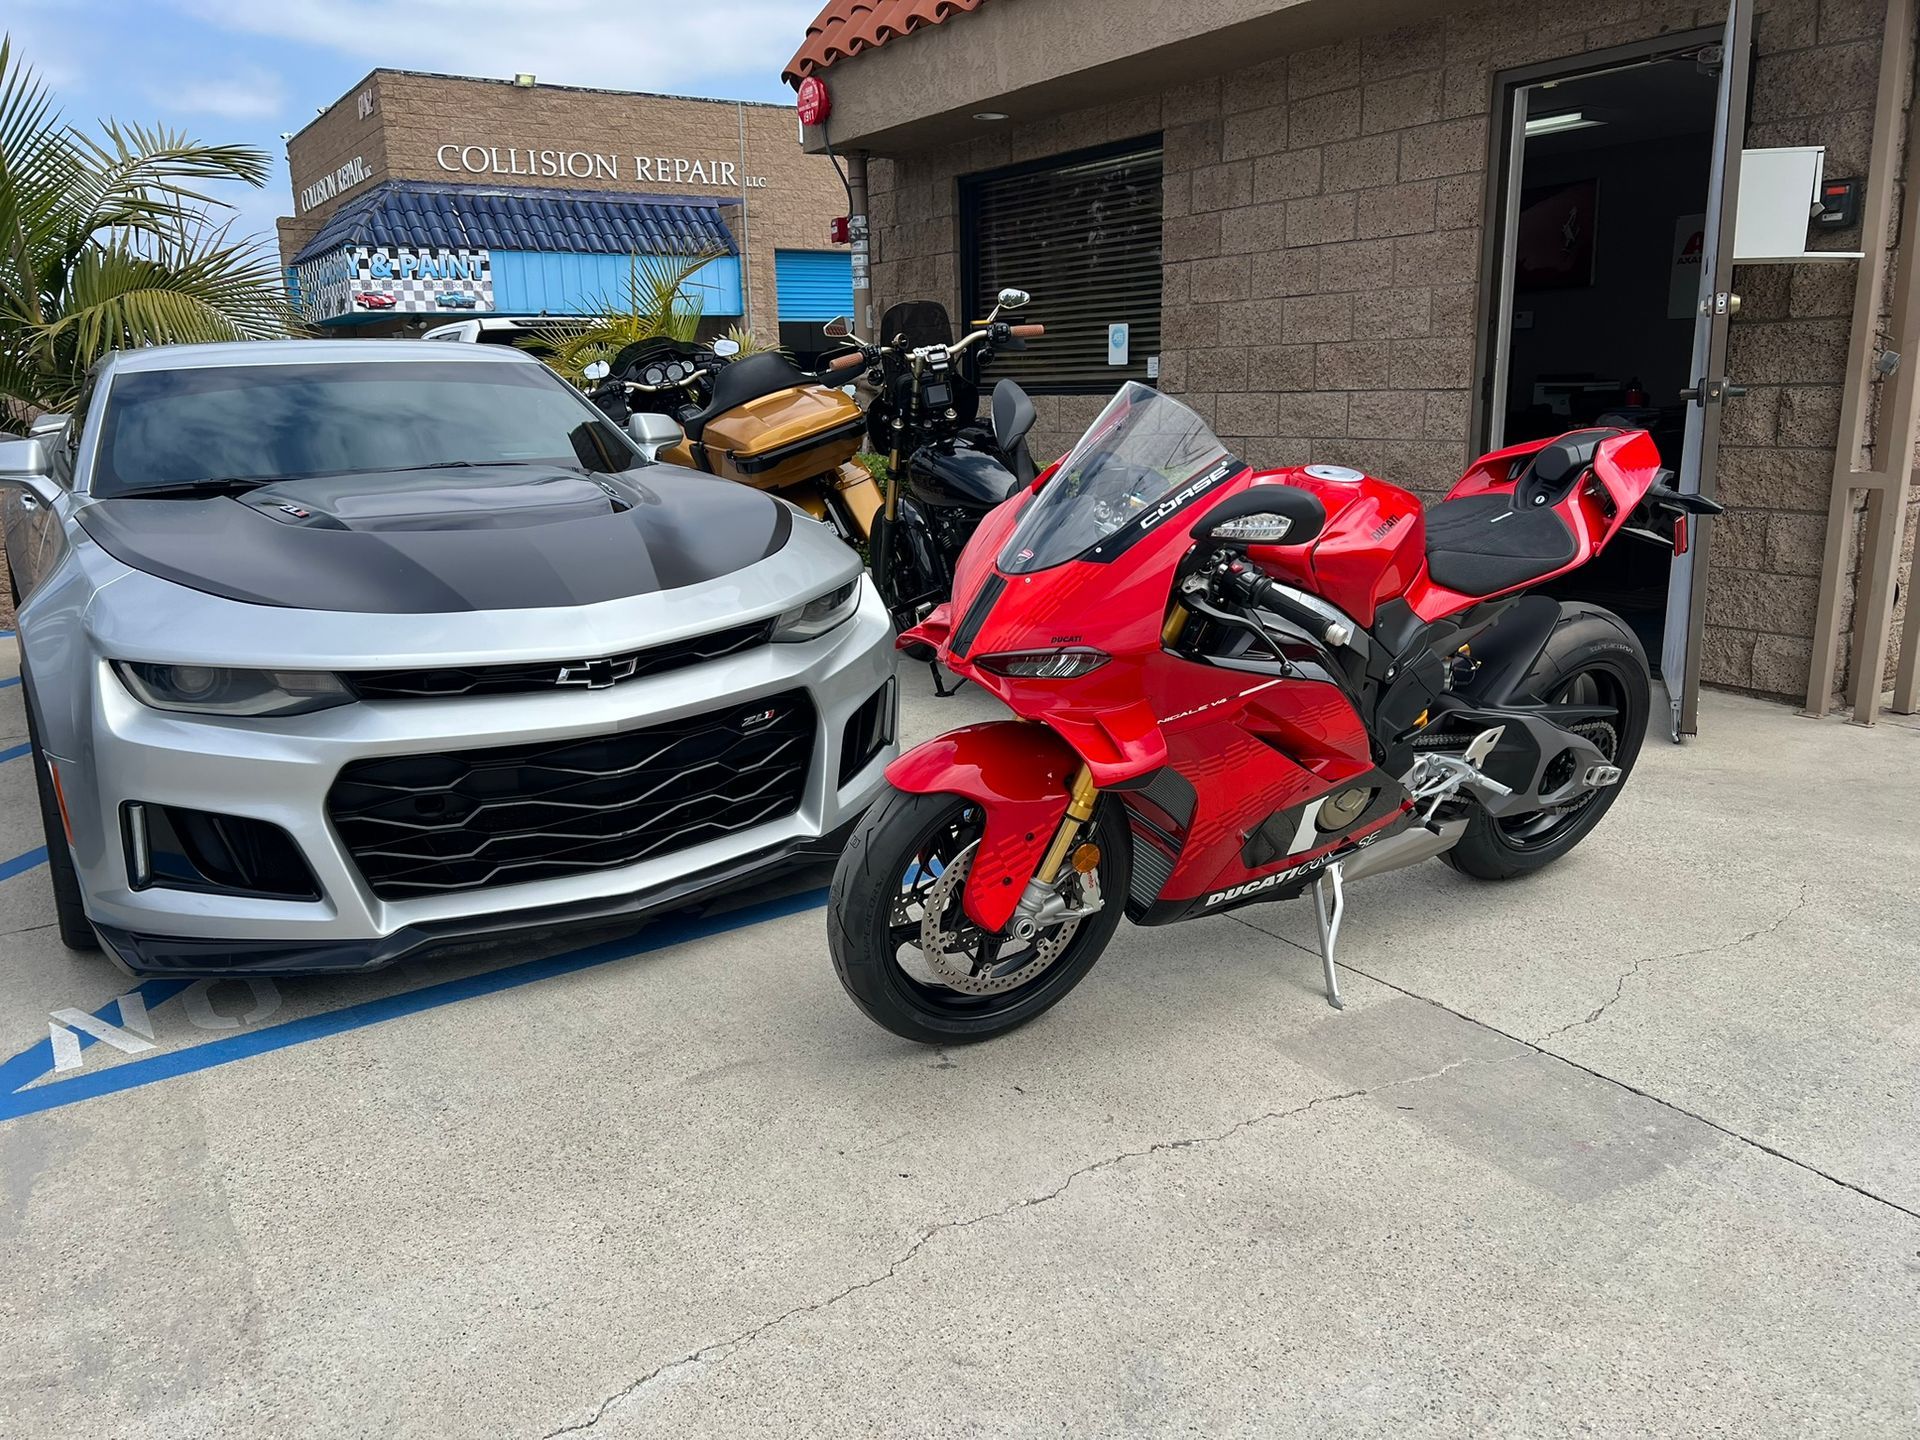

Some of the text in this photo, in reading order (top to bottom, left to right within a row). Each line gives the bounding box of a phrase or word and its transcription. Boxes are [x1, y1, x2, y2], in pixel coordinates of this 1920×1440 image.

[437, 144, 767, 188] COLLISION REPAIR LLC
[301, 173, 337, 212] COLLISION
[336, 156, 365, 193] REPAIR
[370, 253, 394, 279] &
[401, 254, 486, 280] PAINT
[1677, 255, 1704, 265] AXA
[1140, 460, 1230, 530] CORSE
[1371, 513, 1401, 542] DUCATI
[1050, 635, 1083, 643] DUCATI
[1157, 704, 1209, 725] NIGALE
[1205, 867, 1300, 907] DUCATI
[48, 978, 283, 1072] NO
